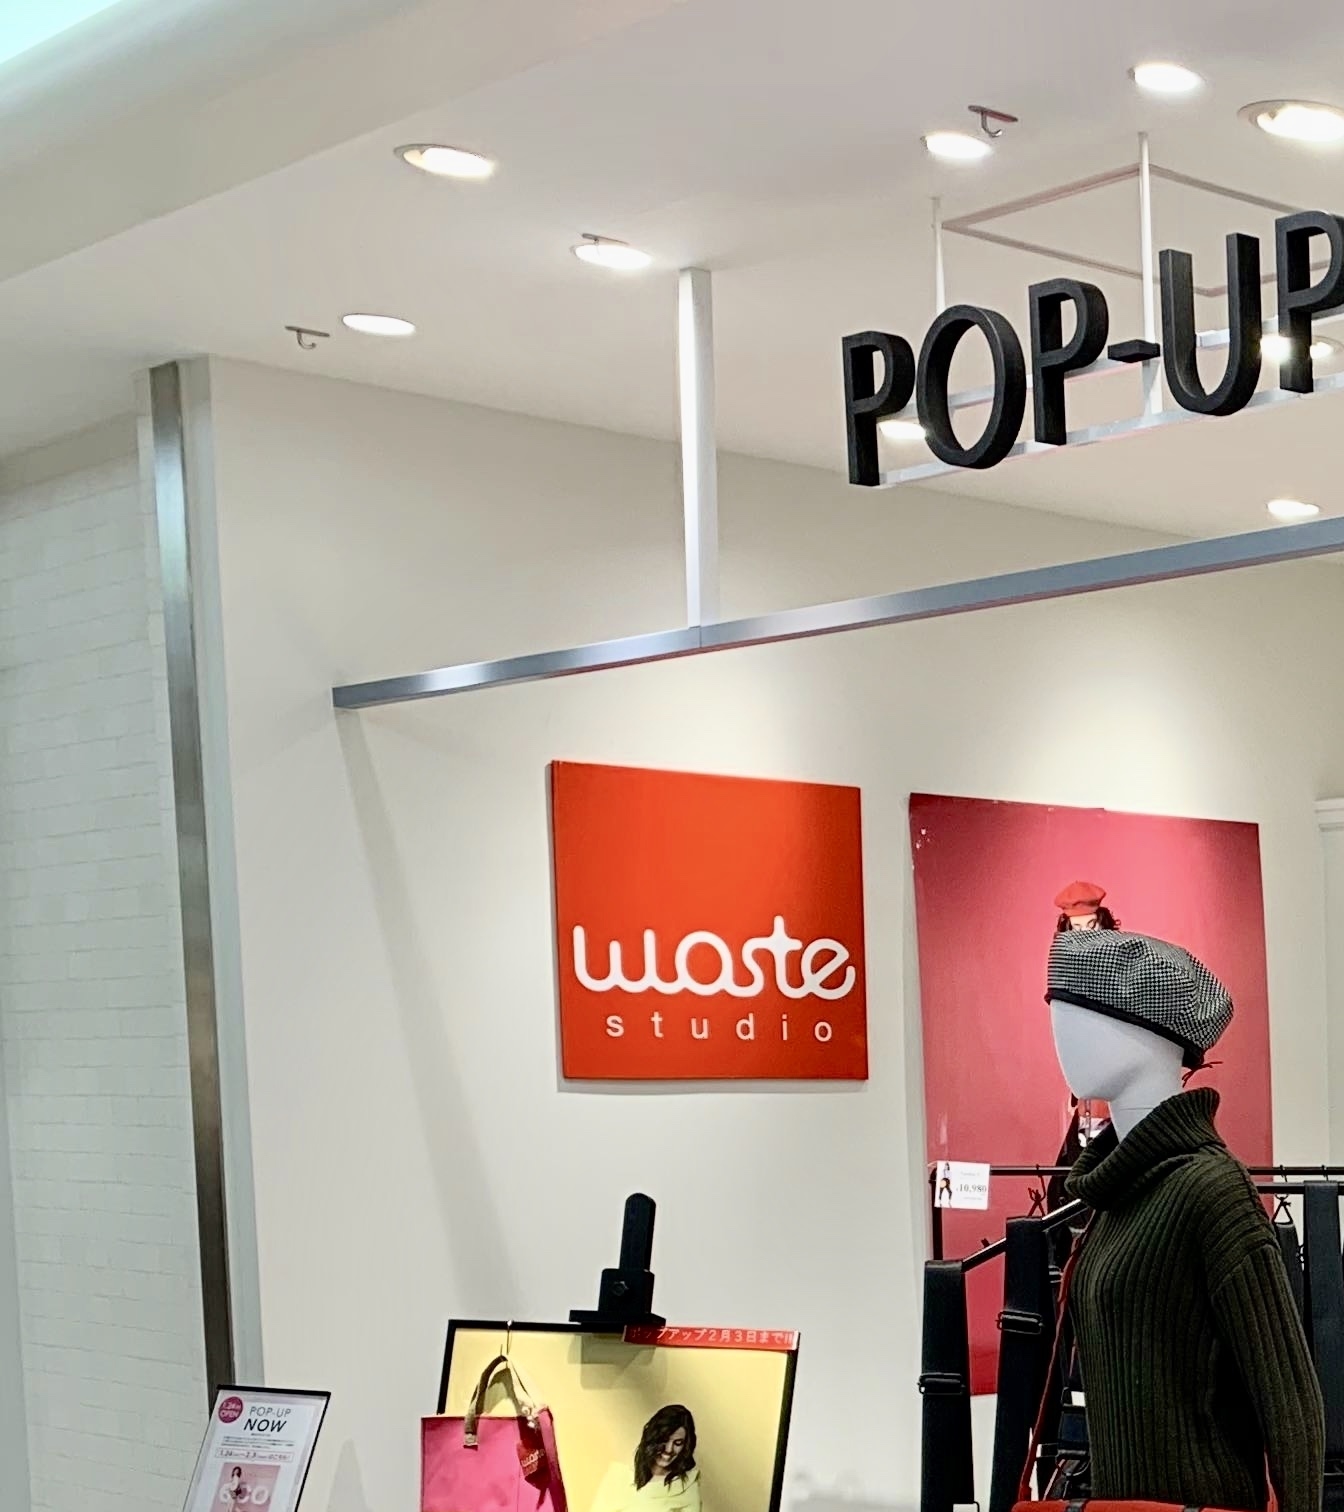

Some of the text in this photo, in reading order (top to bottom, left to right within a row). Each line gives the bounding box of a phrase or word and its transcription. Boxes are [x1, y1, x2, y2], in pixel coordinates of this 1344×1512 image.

[573, 915, 857, 1001] waste
[604, 1012, 834, 1043] studio
[248, 1406, 292, 1418] POP-UP
[243, 1418, 287, 1433] NOW
